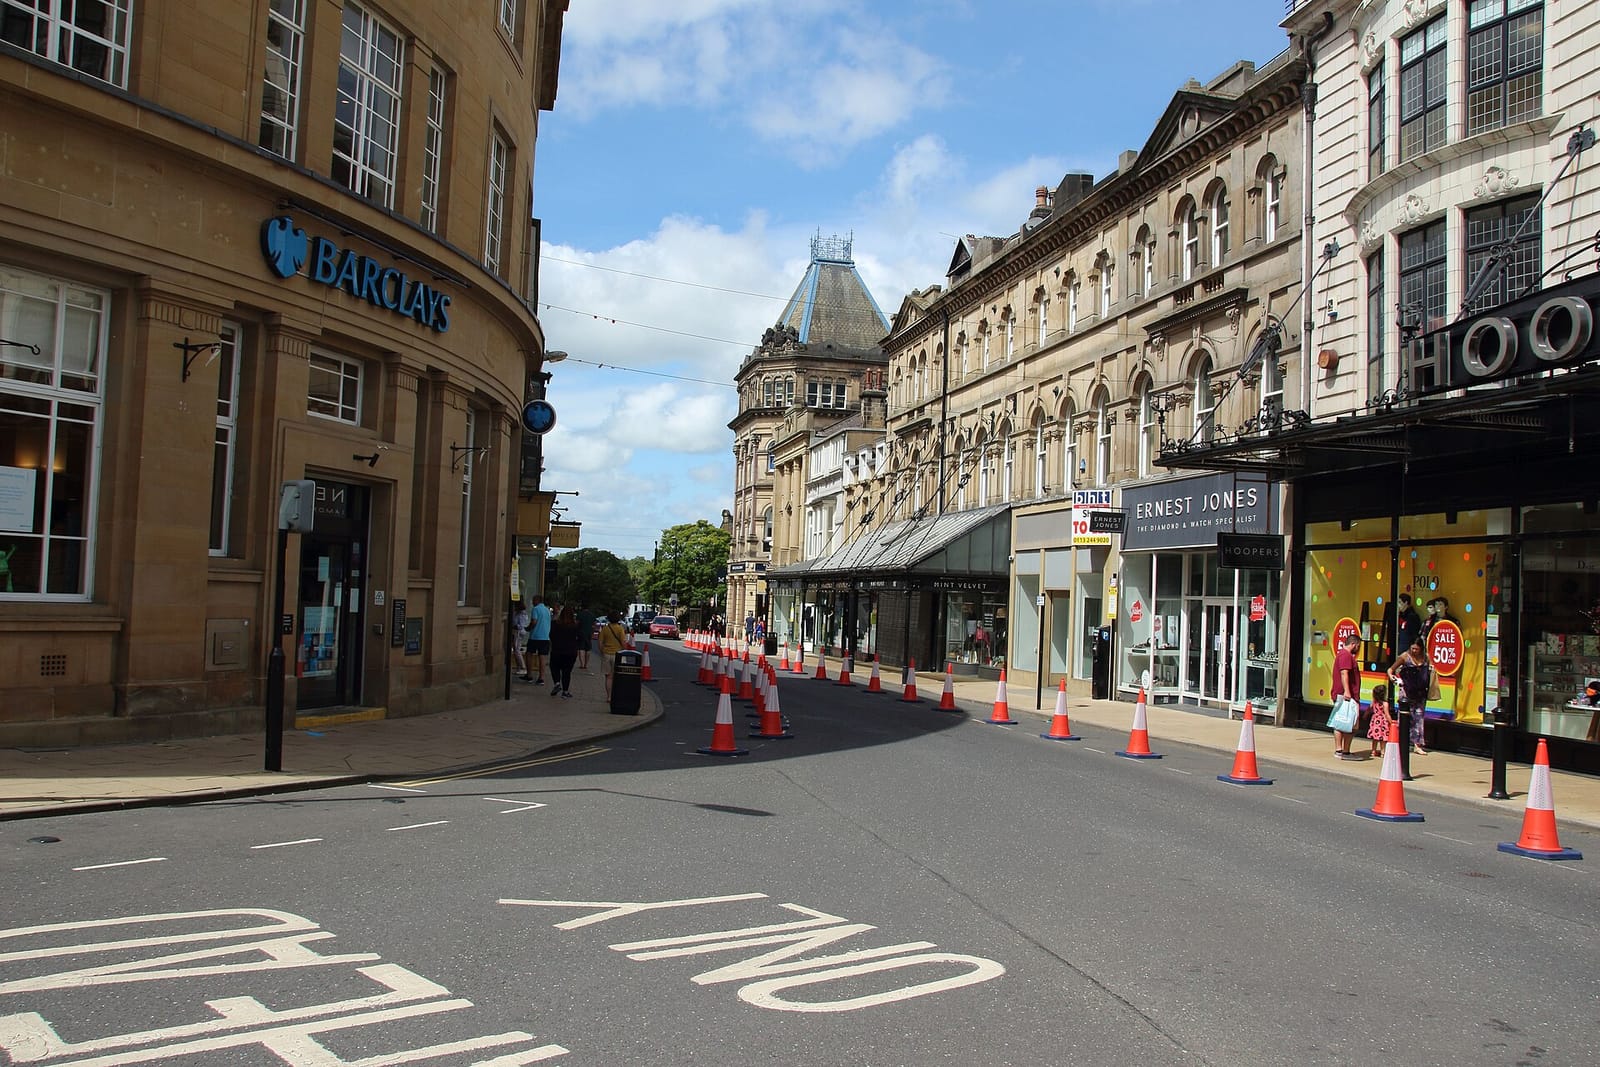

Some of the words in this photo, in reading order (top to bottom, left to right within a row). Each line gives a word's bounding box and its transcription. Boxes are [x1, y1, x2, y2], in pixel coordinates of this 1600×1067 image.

[313, 236, 451, 333] BARCLAYS
[1137, 496, 1192, 519] ERNEST
[1202, 487, 1257, 512] JONES
[1073, 520, 1087, 534] TO
[1151, 522, 1179, 531] DIAMOND
[1182, 521, 1187, 529] &
[1190, 519, 1211, 527] WATCH
[1215, 514, 1257, 525] SPECALIST
[1225, 546, 1280, 557] HOOPERS
[1413, 575, 1439, 589] POLO
[1435, 633, 1456, 643] SALE
[1433, 646, 1456, 664] 50%
[499, 893, 1006, 1013] ONLY
